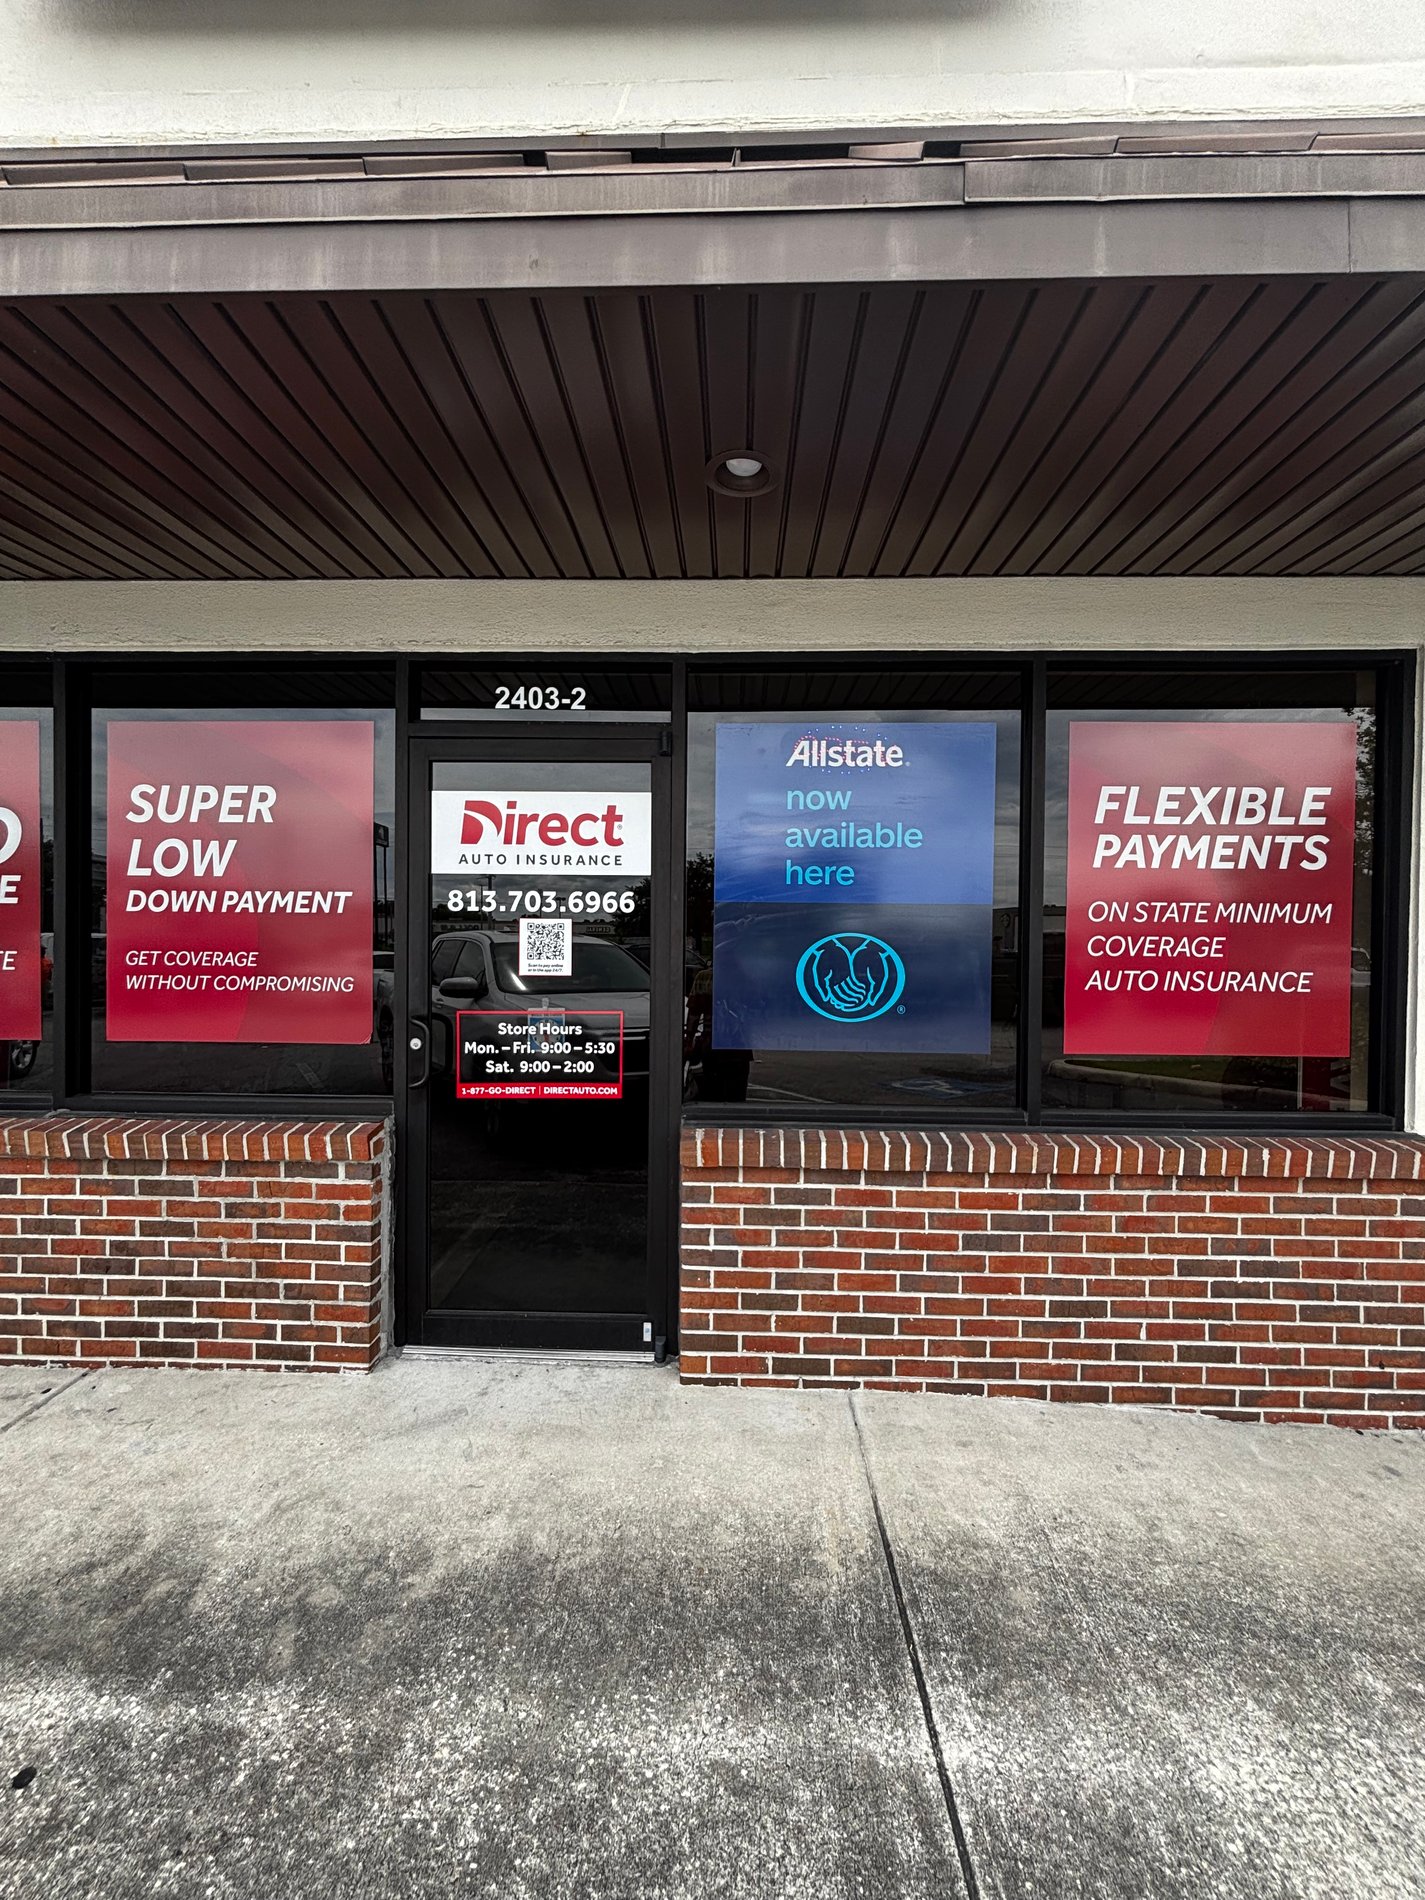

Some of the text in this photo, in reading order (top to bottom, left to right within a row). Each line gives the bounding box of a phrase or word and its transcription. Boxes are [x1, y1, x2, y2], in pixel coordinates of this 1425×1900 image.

[495, 687, 585, 709] 2403-2
[786, 740, 902, 767] Allstate
[126, 784, 276, 823] SUPER
[787, 791, 851, 810] now
[1095, 786, 1331, 825] FLEXIBLE
[461, 801, 624, 846] Direct
[784, 822, 923, 848] available
[127, 839, 237, 877] LOW
[459, 854, 622, 865] AUTO INSURANCE
[1093, 834, 1329, 870] PAYMENTS
[786, 860, 854, 885] here
[126, 890, 353, 913] DOWN PAYMENT
[448, 890, 635, 913] 813.703.6966
[1089, 901, 1332, 923] ON STATE MINIMUM
[1088, 936, 1226, 957] COVERAGE
[126, 951, 258, 966] GET COVERAGE
[127, 975, 354, 992] WITHOUT COMPROMISING
[1085, 970, 1313, 992] AUTO INSURANCE
[498, 1023, 582, 1036] Store Hours
[465, 1042, 499, 1054] Mon.
[513, 1041, 535, 1054] Fri.
[541, 1042, 571, 1054] 9:00
[585, 1042, 615, 1055] 5:30
[486, 1060, 514, 1073] Sat.
[462, 1087, 617, 1095] 1-877-GO-DIRECT DIRECTAUTO.COM
